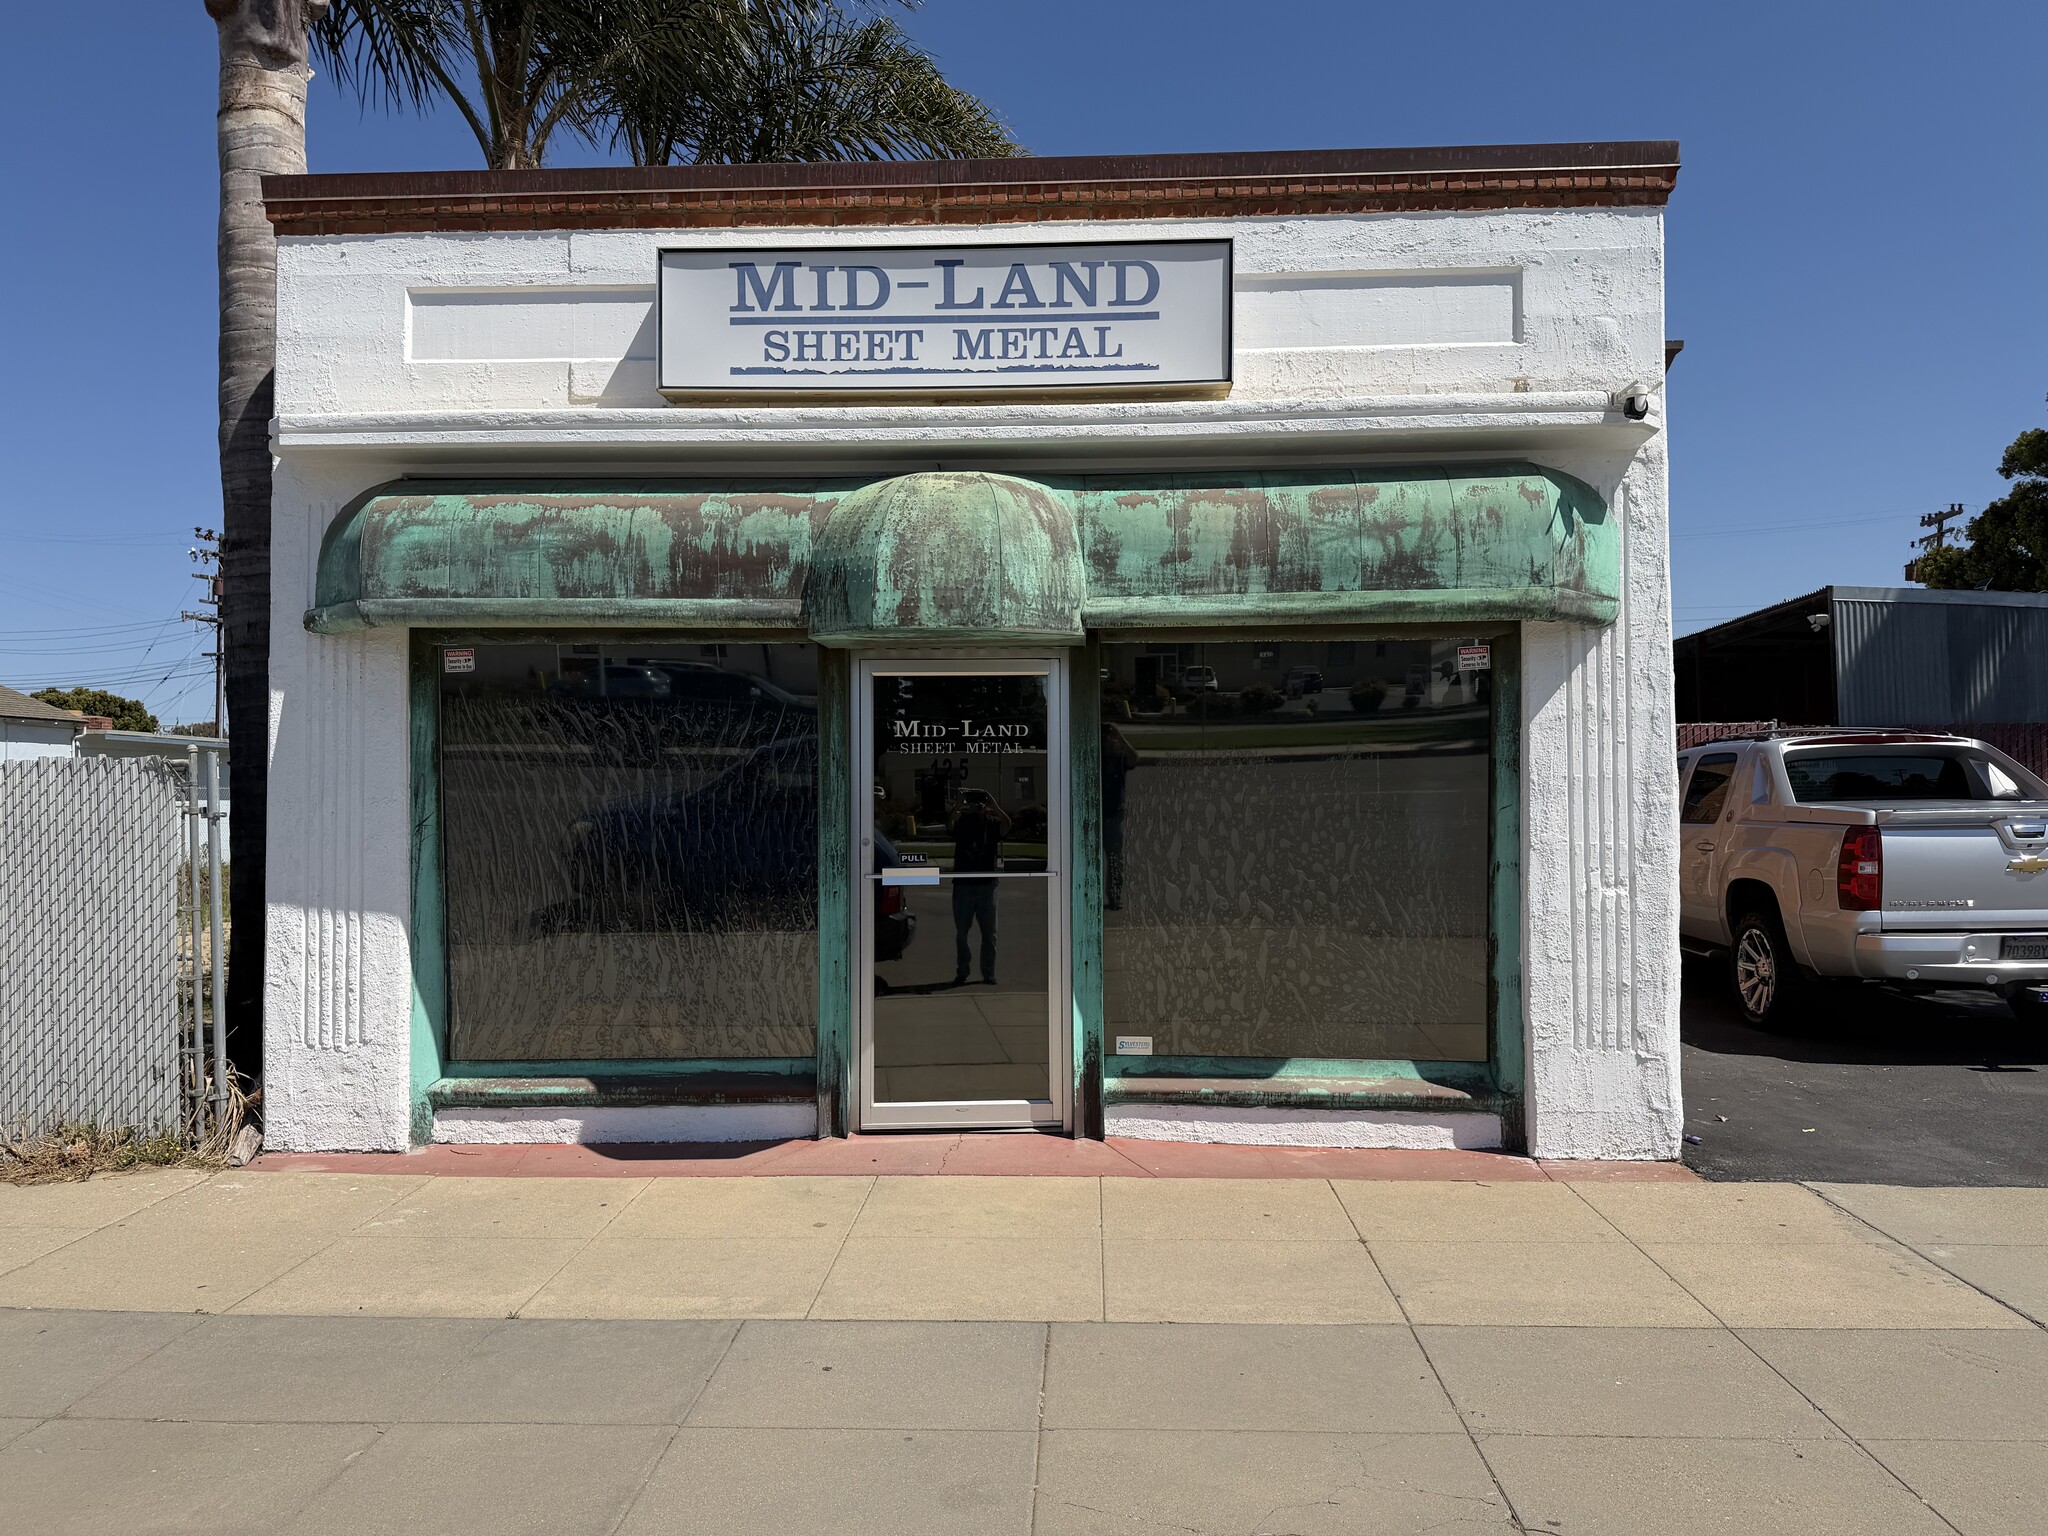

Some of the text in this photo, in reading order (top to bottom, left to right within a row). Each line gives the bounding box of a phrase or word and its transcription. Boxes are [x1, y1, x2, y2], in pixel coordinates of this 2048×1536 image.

[728, 259, 1160, 312] MID-LAND
[763, 326, 1123, 362] SHEET METAL
[1460, 647, 1488, 655] WARNING
[894, 720, 1029, 738] MID-LAND
[900, 742, 1023, 754] SHEET METAL
